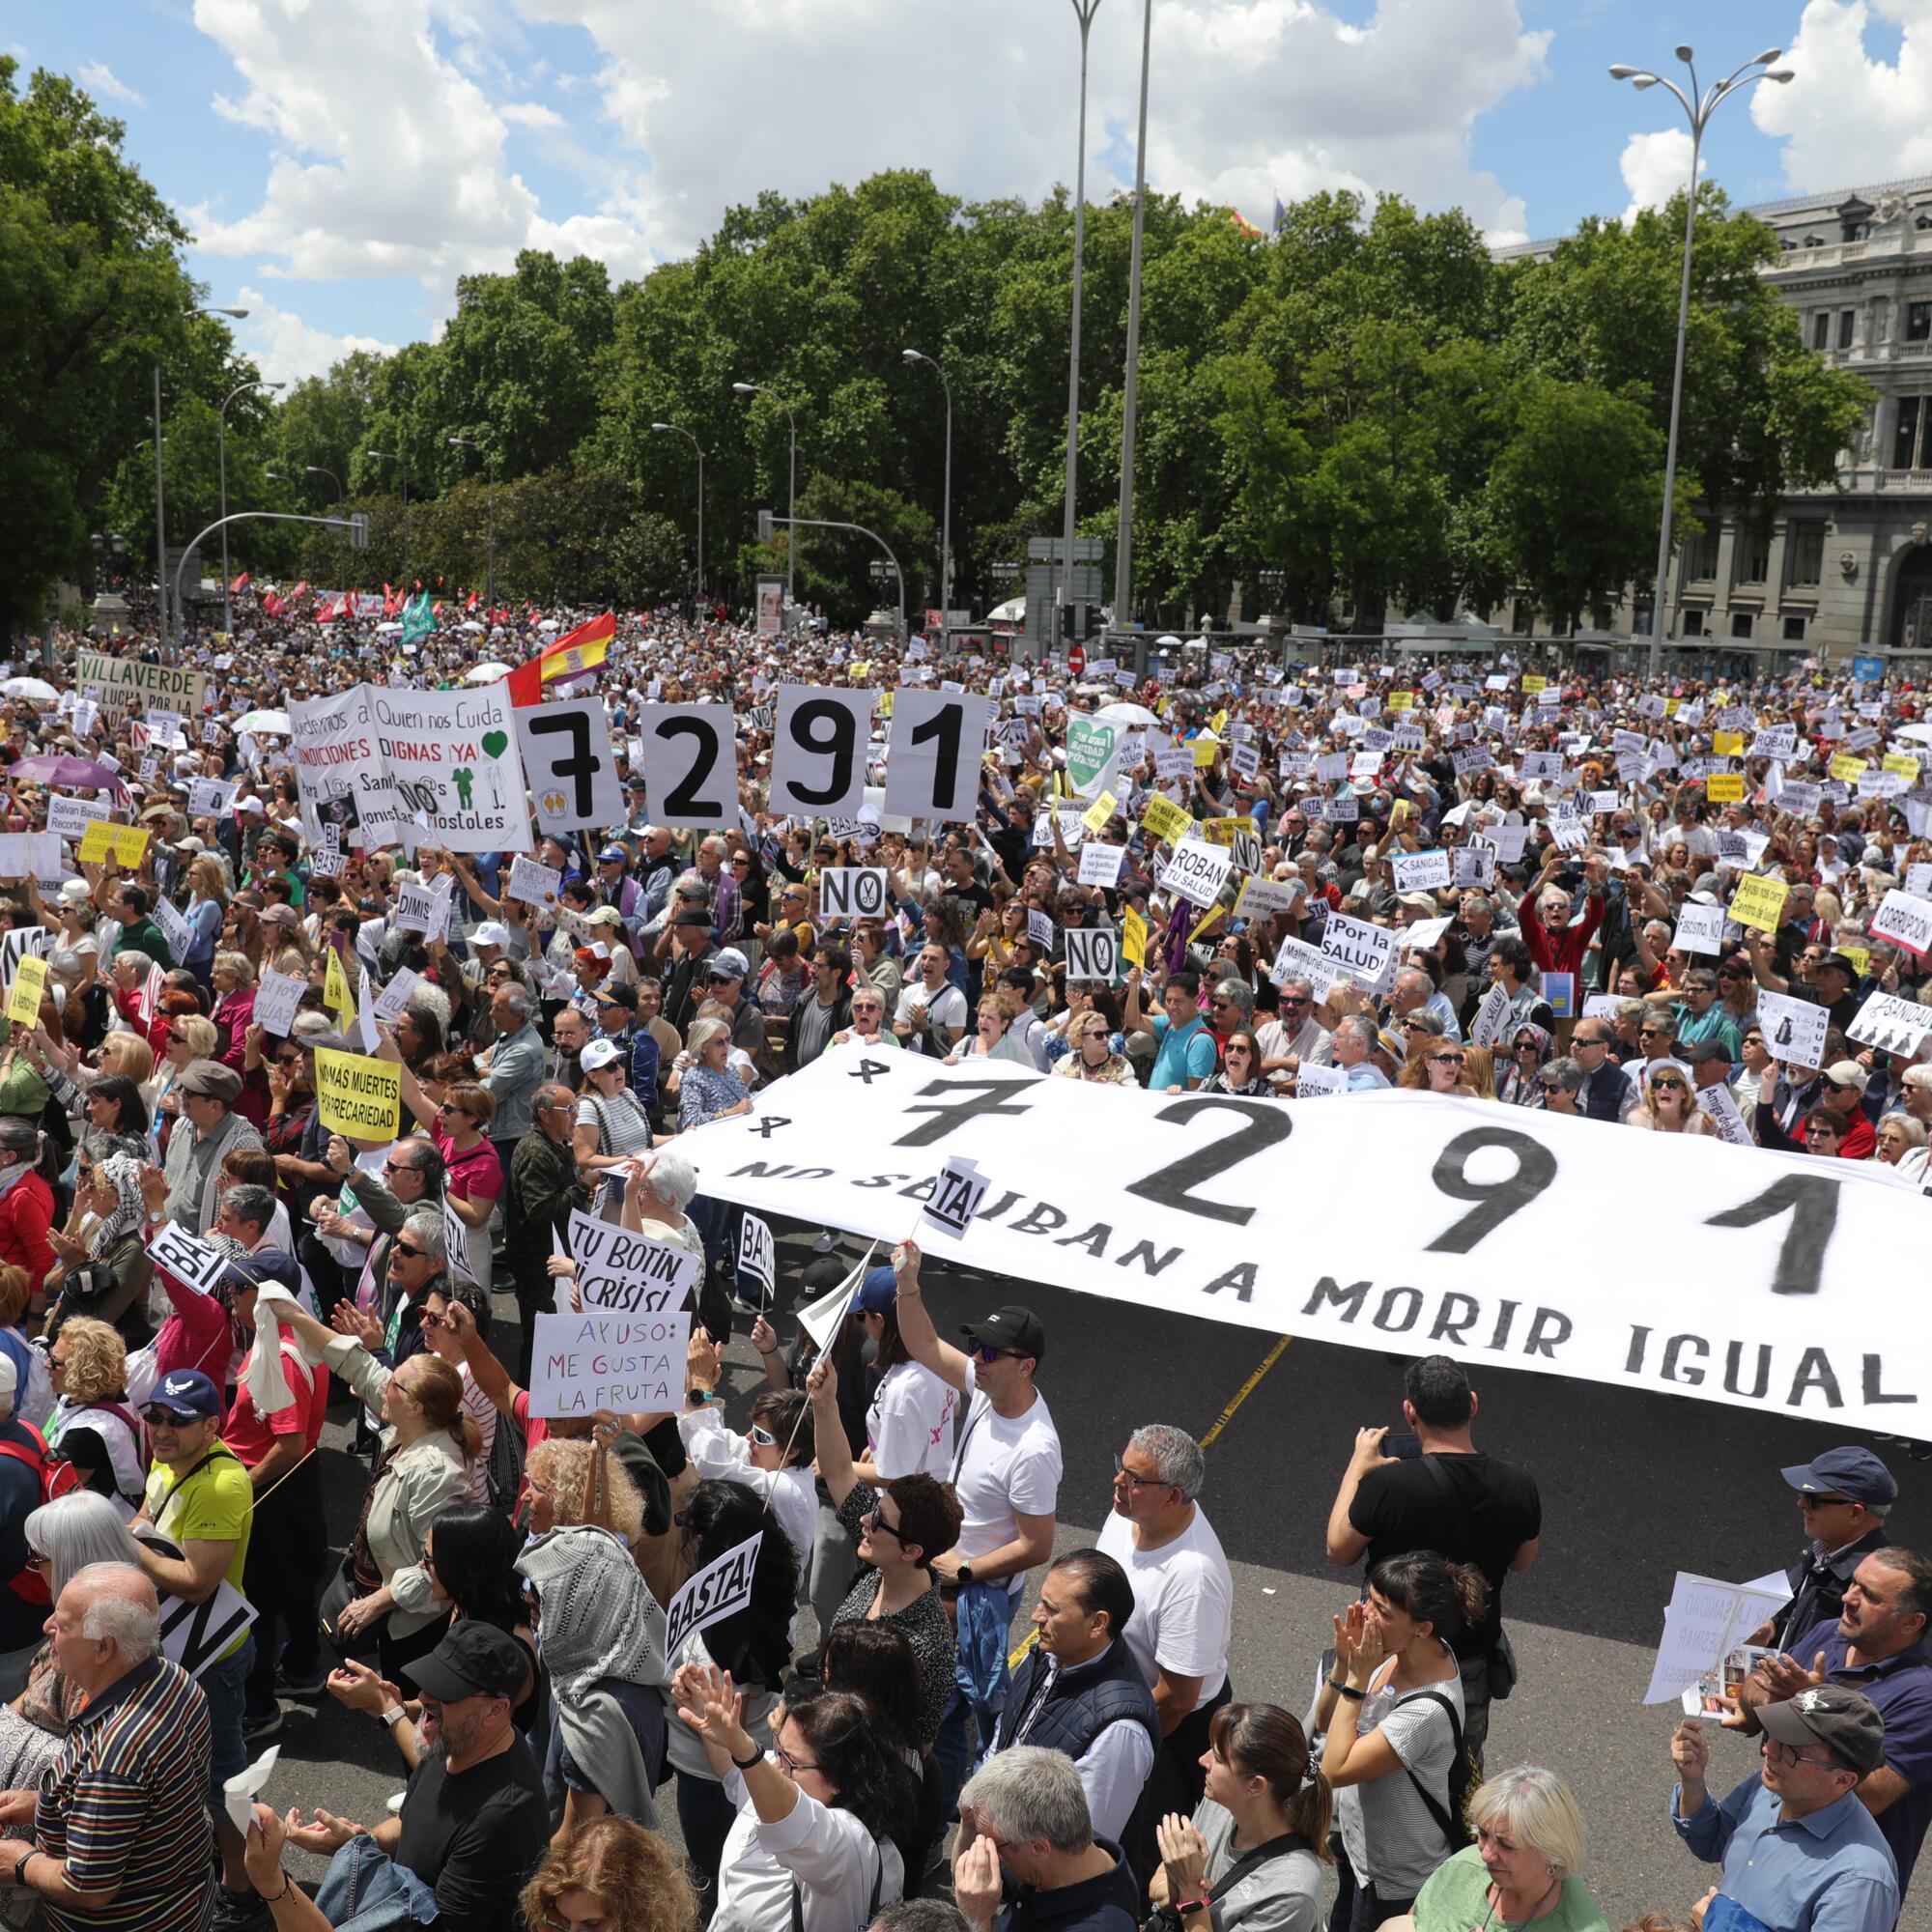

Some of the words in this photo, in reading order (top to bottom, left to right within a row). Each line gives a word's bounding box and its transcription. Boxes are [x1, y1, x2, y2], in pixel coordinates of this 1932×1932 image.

[82, 658, 196, 695] VILLAVERDE
[149, 695, 170, 711] POR
[358, 705, 371, 724] a
[376, 700, 423, 728] Quien
[428, 712, 451, 730] nos
[456, 698, 503, 729] Cuida
[752, 708, 770, 725] NO
[379, 738, 442, 762] DIGNAS
[786, 698, 856, 806] 9
[911, 703, 963, 810] 1
[1121, 743, 1132, 753] or
[1756, 733, 1793, 750] ROBAN
[529, 711, 601, 818] 7
[655, 715, 724, 818] 2
[1119, 753, 1144, 765] ALUD
[54, 803, 79, 815] Salvan
[80, 807, 107, 821] Bancos
[397, 783, 439, 815] NO
[1301, 801, 1322, 811] ASTA!
[1559, 803, 1574, 820] BAS
[51, 818, 86, 832] Recortan
[326, 825, 338, 844] BA
[317, 852, 345, 873] BAST
[1173, 848, 1228, 887] ROBAN
[1235, 830, 1262, 875] NO
[822, 870, 883, 915] NO
[1166, 869, 1180, 882] TU
[1179, 873, 1216, 899] SALUD!
[399, 895, 432, 920] DIMIS
[1308, 902, 1329, 917] STA!
[1326, 918, 1368, 941] ¡Por
[1372, 927, 1389, 951] la
[1066, 931, 1114, 977] NO
[1321, 940, 1384, 974] SALUD!
[319, 1063, 332, 1083] NO
[330, 1064, 351, 1090] MÁS
[350, 1070, 398, 1100] MUERTES
[321, 1091, 333, 1111] POR
[329, 1094, 397, 1129] PRECARIEDAD.
[1705, 1089, 1724, 1117] Amiga
[891, 1078, 1046, 1148] 7
[1124, 1097, 1293, 1227] 2
[1422, 1125, 1558, 1255] 9
[1701, 1173, 1844, 1296] 1
[925, 1166, 984, 1226] STA!
[157, 1227, 216, 1280] BA
[446, 1212, 472, 1270] STA!
[574, 1220, 605, 1257] TU
[728, 1160, 836, 1179] NO
[974, 1189, 1186, 1277] IBAN
[1202, 1262, 1260, 1303] A
[1300, 1276, 1574, 1360] MORIR
[1624, 1324, 1918, 1408] IGUAL
[577, 1320, 676, 1345] AYUSO:
[548, 1354, 579, 1380] ME
[592, 1354, 670, 1375] GUSTA
[558, 1389, 586, 1411] LA
[595, 1381, 668, 1407] FRUTA
[667, 1543, 760, 1640] BASTA!
